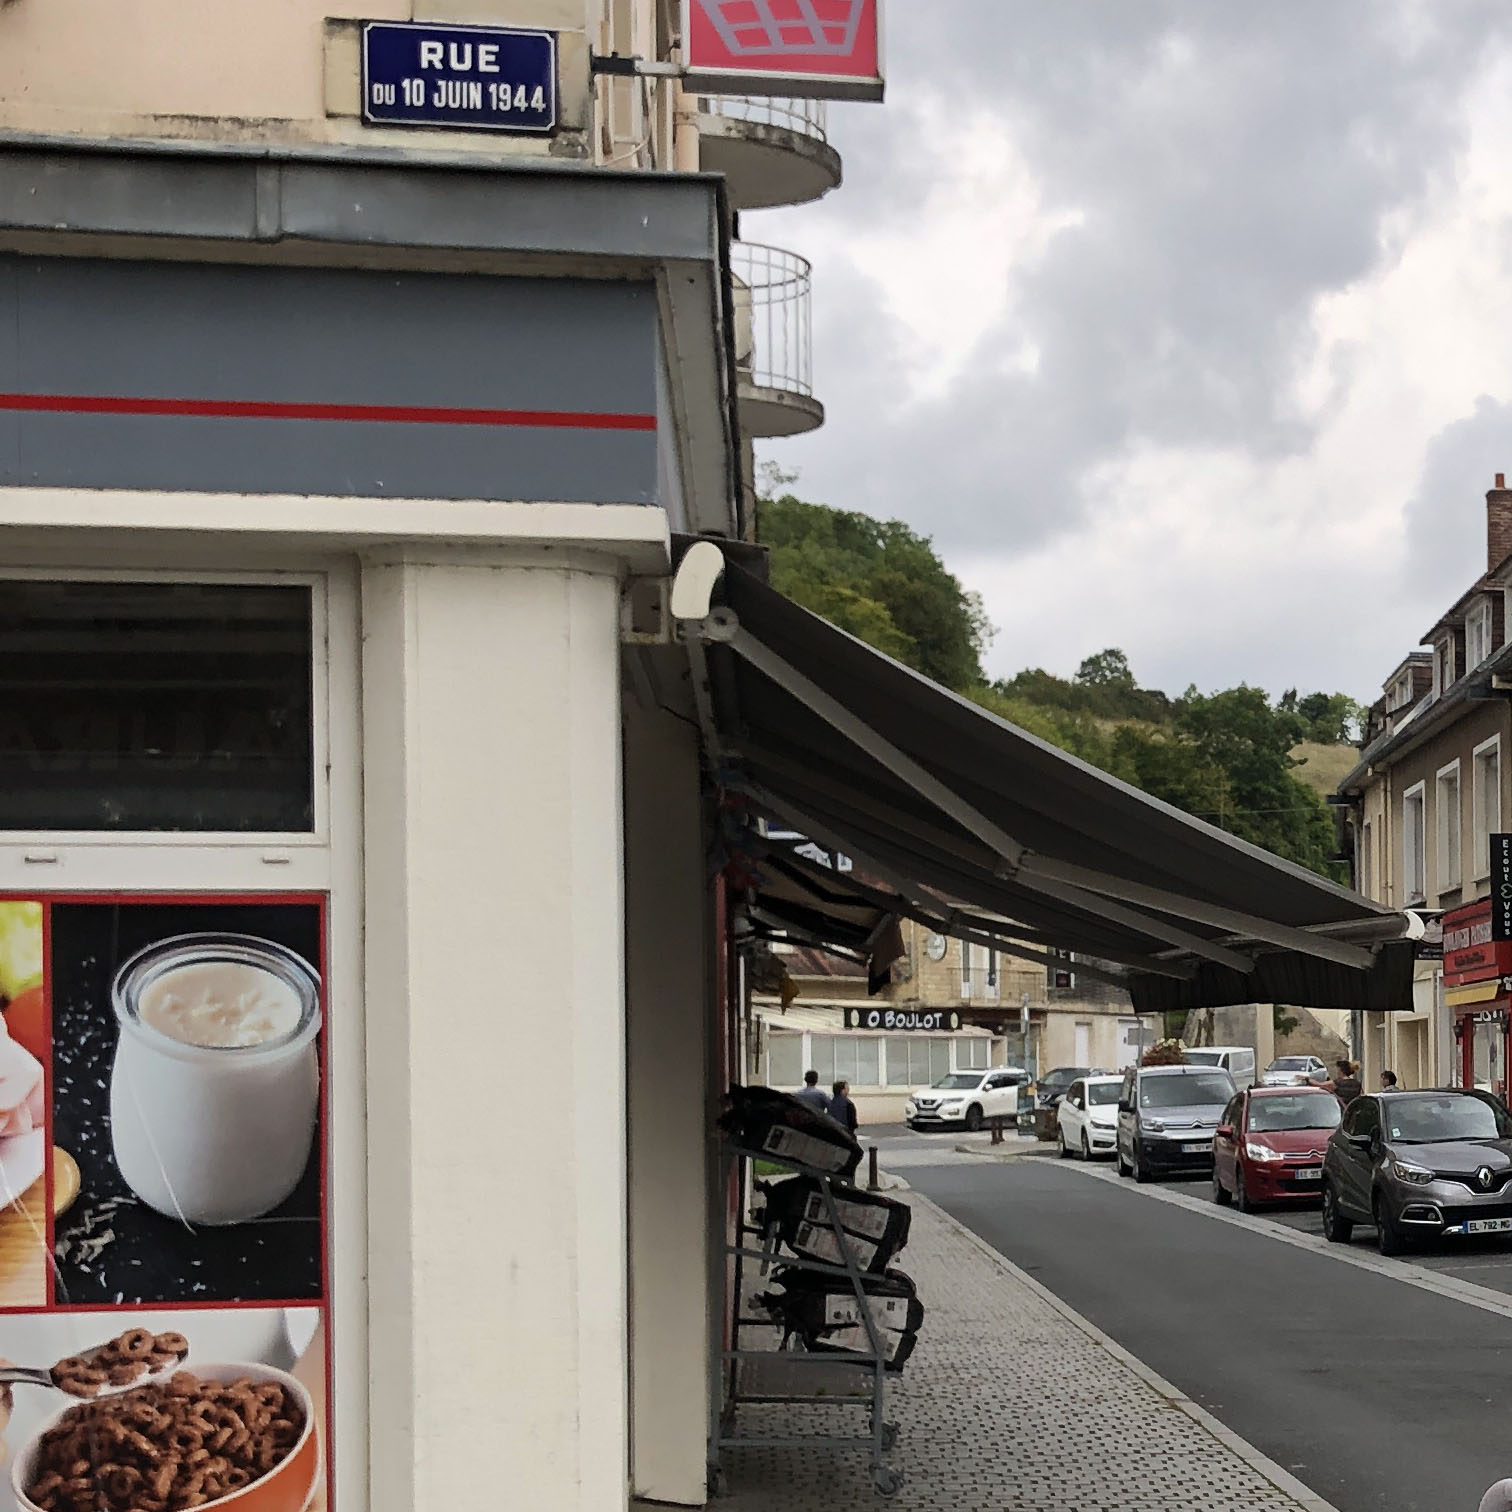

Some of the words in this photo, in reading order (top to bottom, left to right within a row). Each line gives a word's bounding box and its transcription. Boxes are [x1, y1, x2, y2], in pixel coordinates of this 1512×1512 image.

[420, 40, 500, 73] RUE
[372, 82, 396, 106] DU
[401, 78, 425, 107] 10
[433, 80, 482, 110] JUIN
[488, 82, 547, 112] 1944
[884, 1010, 943, 1029] BOULOT
